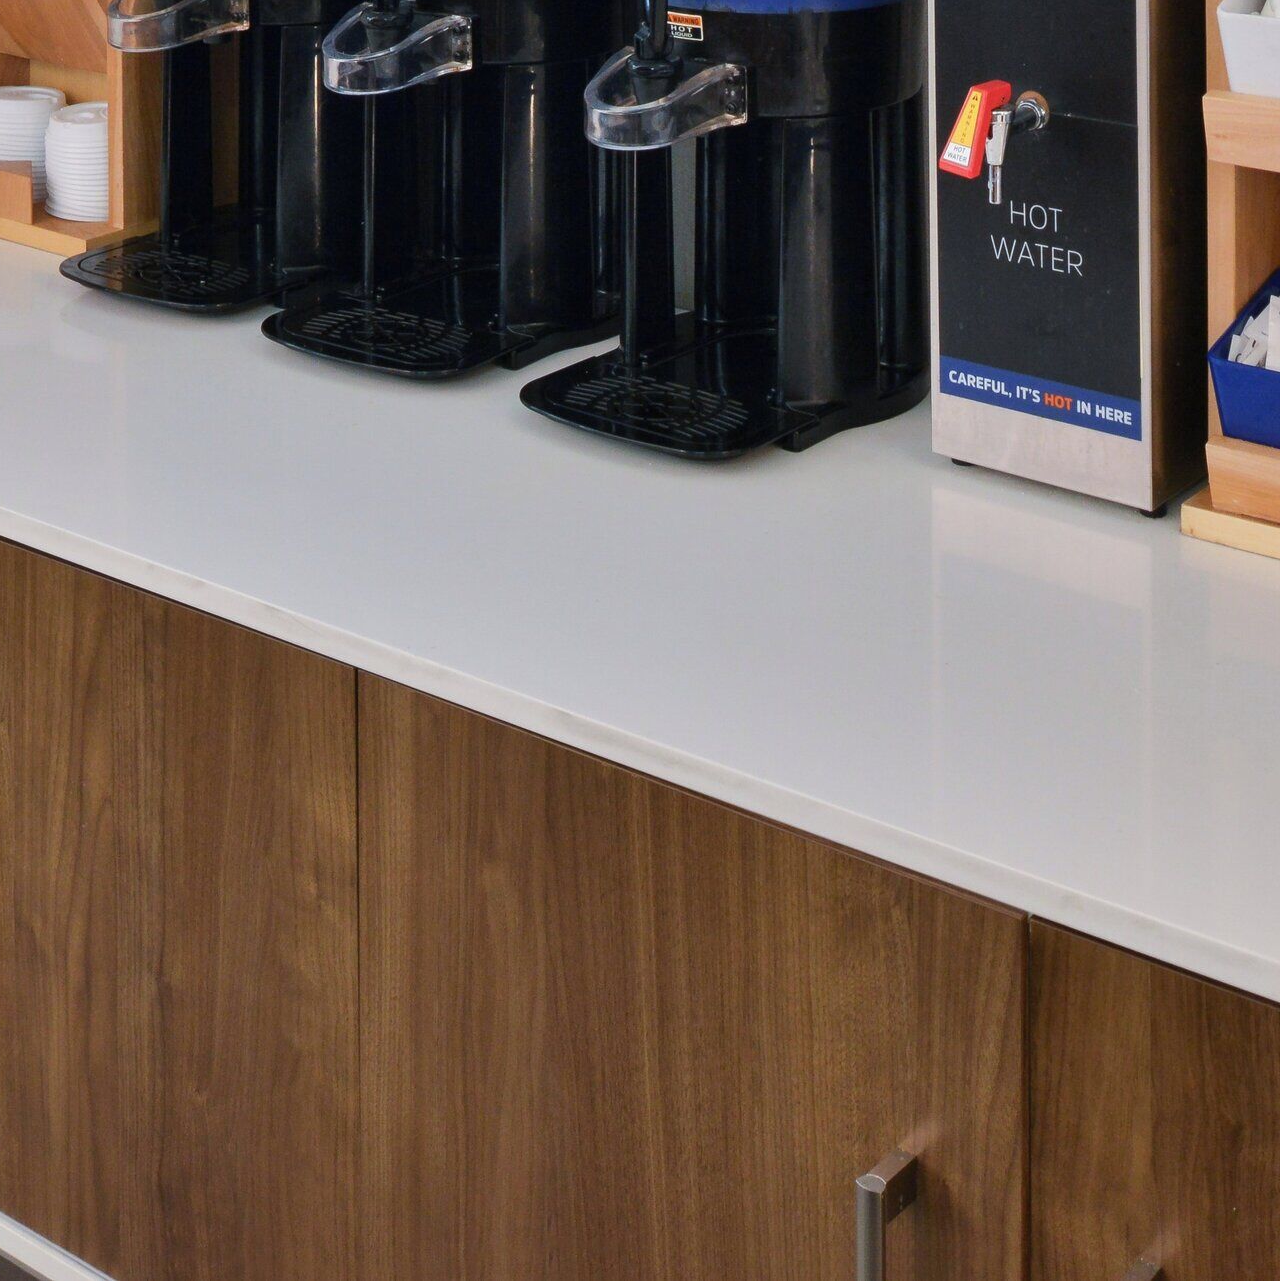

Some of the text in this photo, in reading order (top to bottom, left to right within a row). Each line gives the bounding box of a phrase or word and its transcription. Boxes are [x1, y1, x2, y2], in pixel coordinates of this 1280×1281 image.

[671, 24, 693, 33] HOT
[671, 30, 693, 38] LIQUID
[953, 145, 966, 153] HOT
[947, 152, 968, 162] WATER
[1010, 200, 1063, 233] HOT
[990, 234, 1083, 277] WATER
[949, 370, 1132, 425] CAREFUL, IT'S HOT IN HERE
